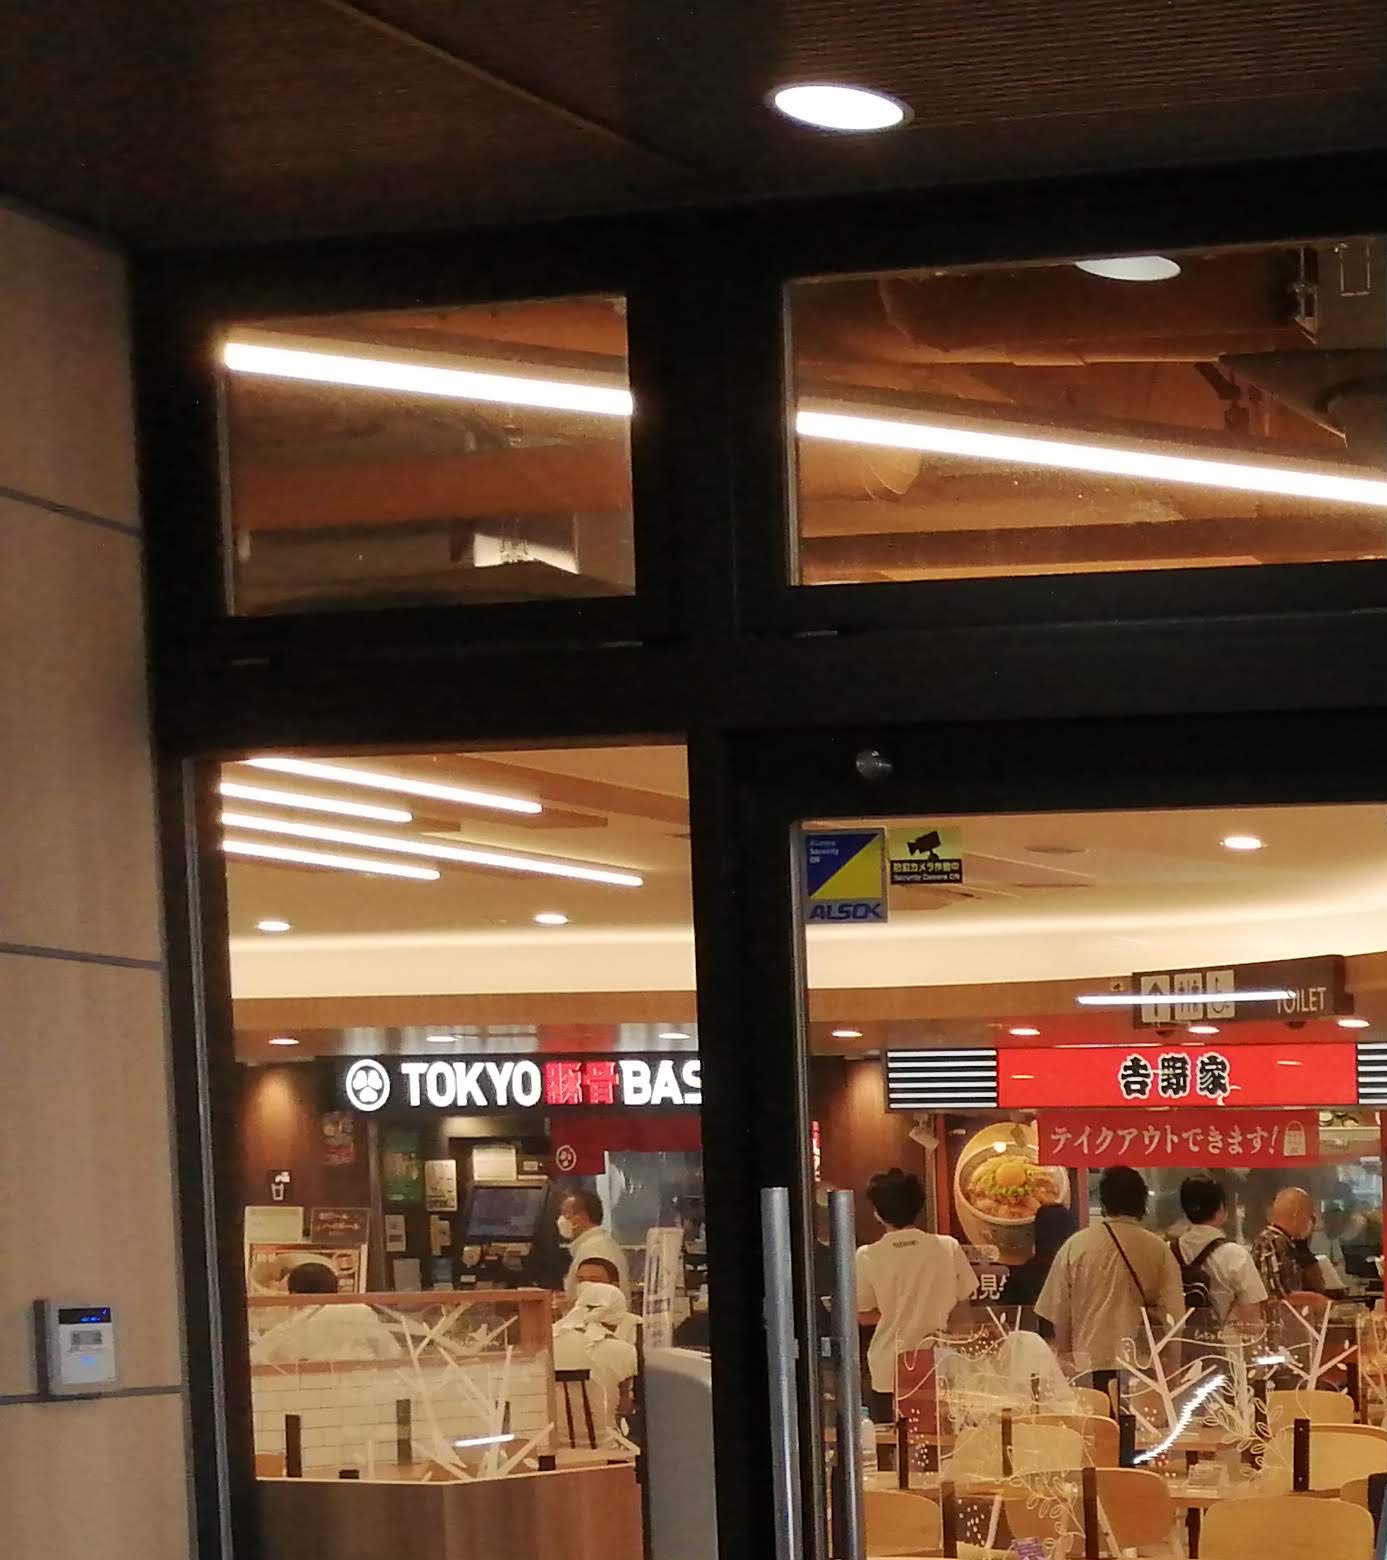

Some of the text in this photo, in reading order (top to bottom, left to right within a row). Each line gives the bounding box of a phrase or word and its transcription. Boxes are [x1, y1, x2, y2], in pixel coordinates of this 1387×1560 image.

[893, 873, 922, 881] Security
[923, 873, 948, 881] Camera
[808, 902, 883, 920] ALSOK
